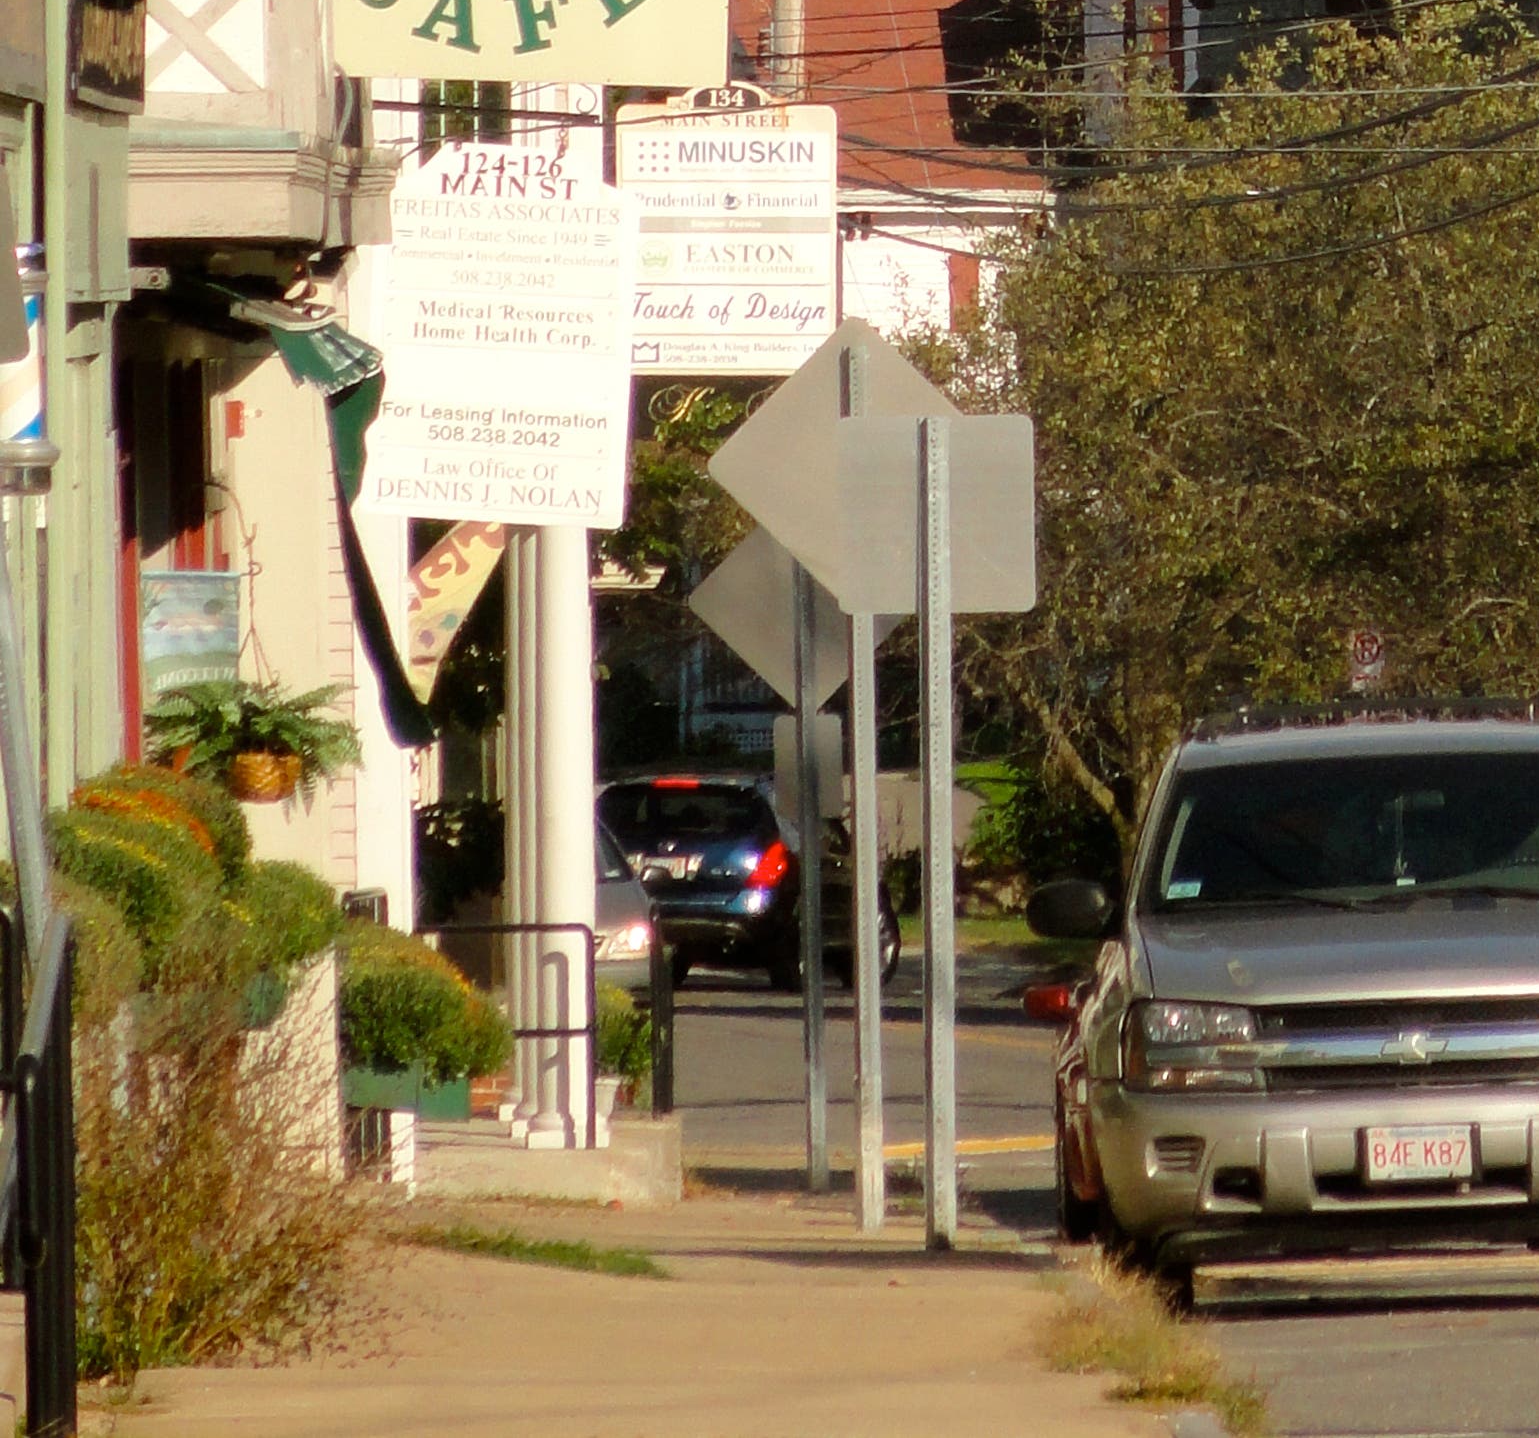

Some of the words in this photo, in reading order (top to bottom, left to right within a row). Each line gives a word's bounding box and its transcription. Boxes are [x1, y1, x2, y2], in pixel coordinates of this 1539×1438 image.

[708, 89, 745, 107] 134
[660, 114, 712, 128] MAIN
[721, 114, 793, 128] STREET
[678, 140, 814, 163] MINUSKIN
[462, 151, 563, 178] 124-126
[440, 172, 529, 198] MAIN
[539, 178, 579, 201] ST
[392, 198, 481, 219] FREITAS
[487, 203, 621, 226] ASSOCIATES
[747, 192, 818, 208] Financial
[419, 226, 452, 240] Real
[458, 228, 501, 244] Estate
[506, 231, 547, 245] Since
[553, 233, 588, 246] 1949
[391, 246, 464, 261] Commercial
[552, 255, 620, 268] Residential
[686, 244, 794, 263] EASTON
[418, 300, 493, 320] Medical
[499, 304, 594, 325] Resources
[632, 291, 695, 320] Touch
[707, 294, 735, 326] of
[743, 292, 827, 332] Design
[413, 322, 466, 341] Home
[475, 325, 538, 344] Health
[546, 329, 596, 350] Corp.
[381, 402, 413, 418] For
[420, 404, 494, 427] Leasing
[502, 408, 608, 431] Information
[428, 425, 562, 448] 508.238.2042
[423, 458, 461, 476] Law
[468, 458, 527, 481] Office
[532, 463, 559, 482] Of
[376, 477, 474, 503] DENNIS
[481, 484, 498, 505] J.
[509, 485, 603, 510] NOLAN
[1373, 1140, 1416, 1169] 84E
[1423, 1139, 1467, 1168] K87
